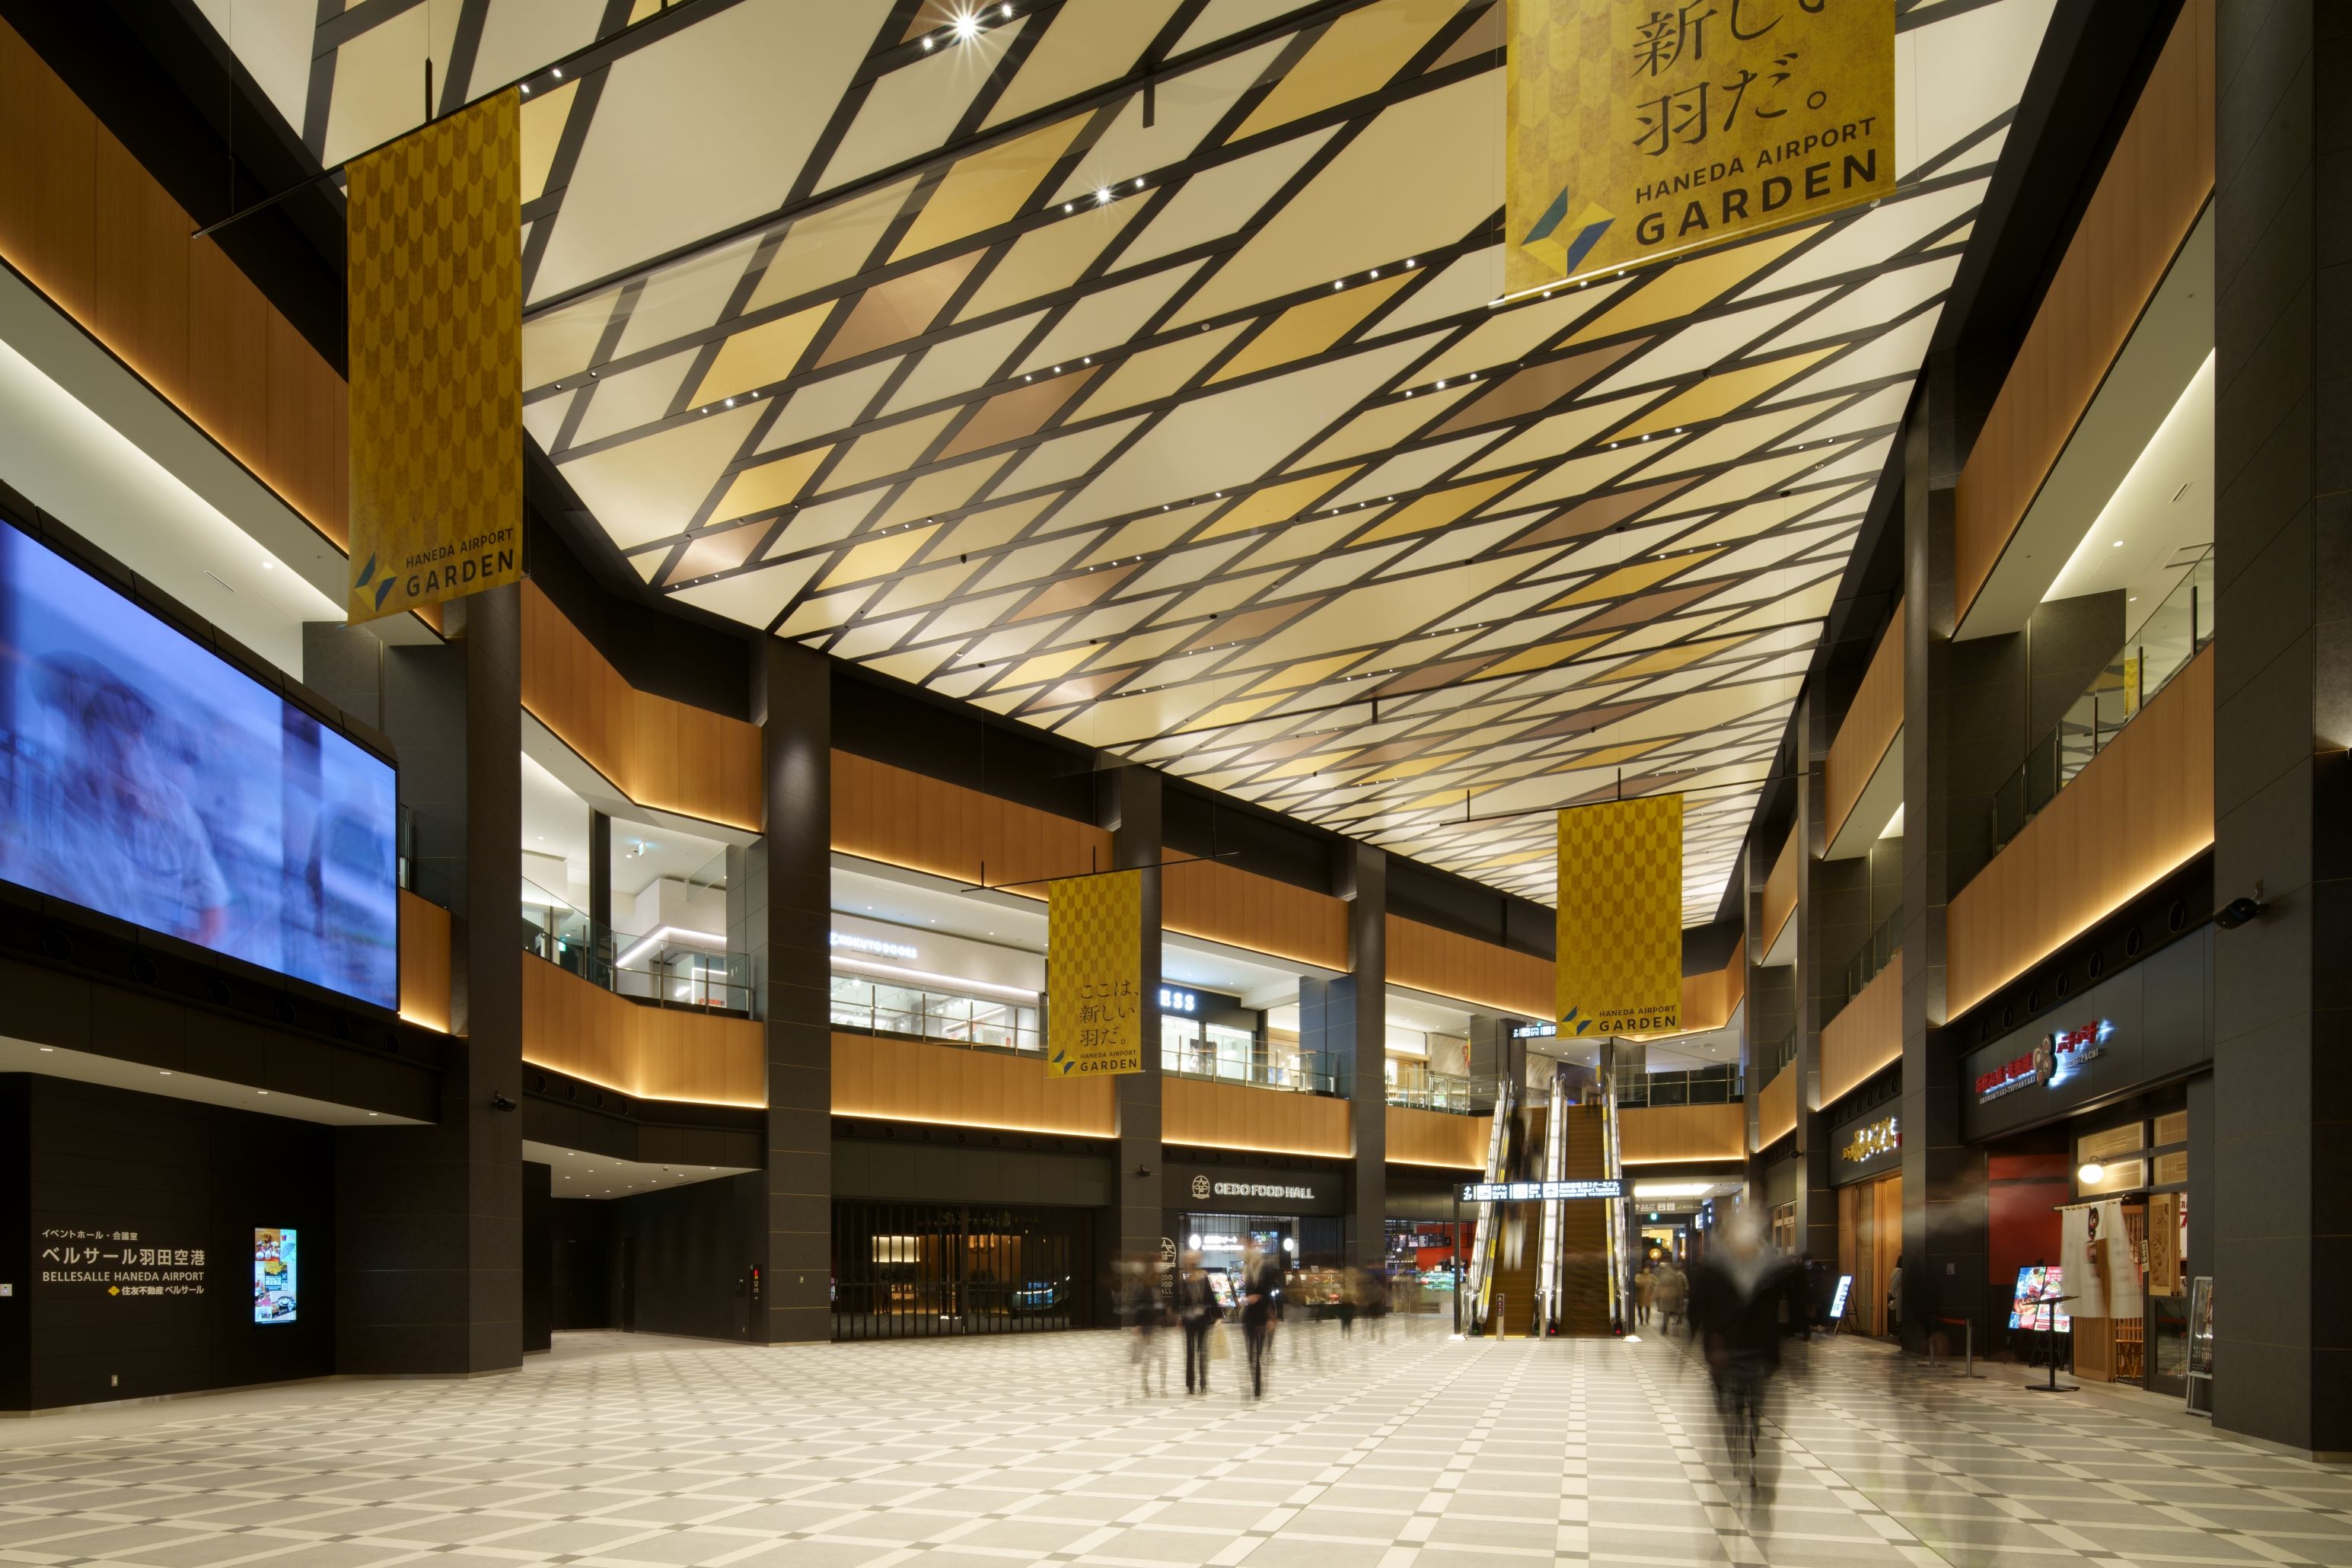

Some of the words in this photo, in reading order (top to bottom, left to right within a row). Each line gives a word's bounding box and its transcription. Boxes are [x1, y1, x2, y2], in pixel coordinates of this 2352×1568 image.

[1630, 0, 1825, 78] 新し
[1631, 52, 1827, 157] 羽だ。
[1636, 157, 1743, 204] HANEDA
[1756, 116, 1876, 168] AIRPORT
[1636, 148, 1877, 246] GARDEN
[406, 547, 455, 569] HANEDA
[460, 527, 514, 553] AIRPORT
[406, 548, 514, 598] GARDEN
[1081, 980, 1139, 999] ここは、
[1079, 1005, 1135, 1024] 新しい
[1599, 1009, 1635, 1018] HANEDA
[1638, 1005, 1675, 1015] AIRPORT
[1599, 1015, 1676, 1031] GARDEN
[1079, 1026, 1127, 1047] 羽だ。
[1080, 1058, 1137, 1072] GARDEN
[1214, 1182, 1250, 1196] OEDO
[1251, 1184, 1285, 1197] FOOD
[1285, 1186, 1315, 1199] HALL
[42, 1229, 138, 1241] イベントホール・会議室
[42, 1247, 205, 1266] ベルサール羽田空港
[43, 1272, 110, 1282] BELLESALLE
[114, 1272, 160, 1282] HANEDA
[162, 1272, 204, 1281] AIRPORT
[121, 1286, 164, 1296] 住友不動産
[165, 1286, 204, 1294] ベルサール
